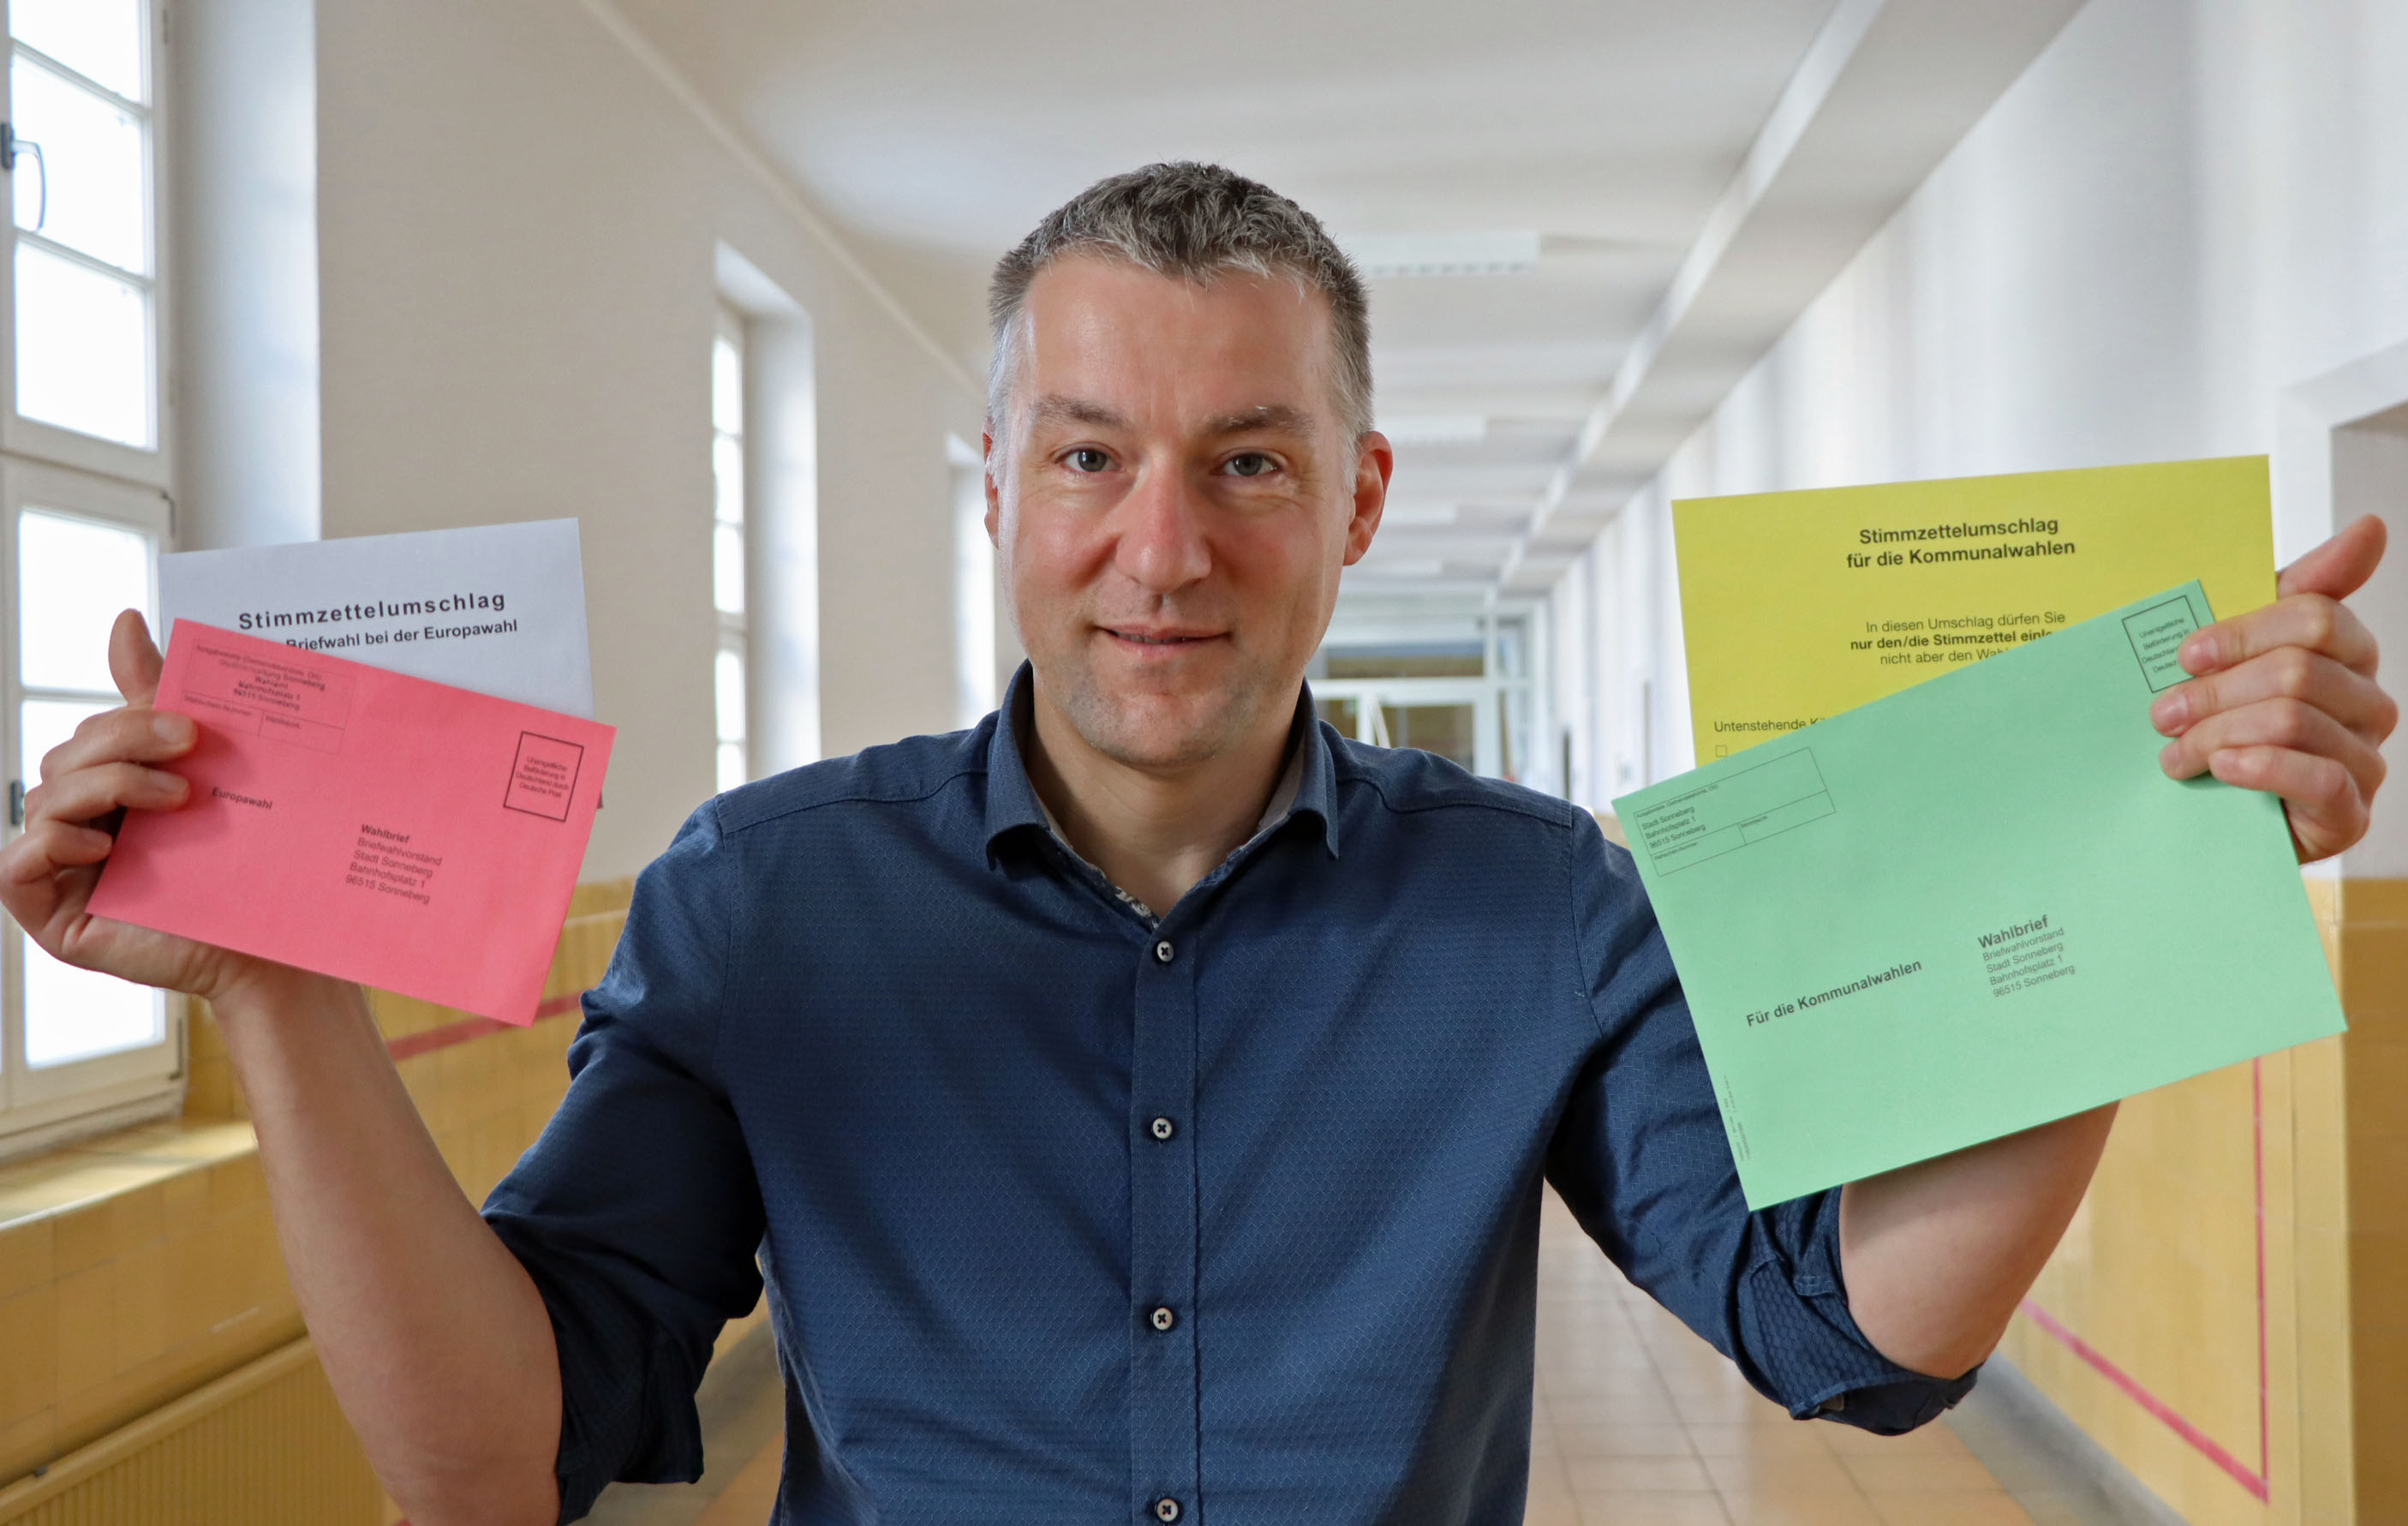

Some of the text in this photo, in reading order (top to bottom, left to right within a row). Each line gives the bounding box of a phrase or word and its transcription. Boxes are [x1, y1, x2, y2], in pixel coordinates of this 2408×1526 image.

[1860, 518, 2058, 544] Stimmzettelumschlag
[1847, 541, 2076, 568] für die Kommunalwahlen
[239, 593, 505, 630] Stimmzettelumschlag
[1866, 611, 2065, 632] In diesen Umschlag dürfen Sie
[365, 631, 389, 644] bei
[393, 629, 418, 643] der
[424, 619, 517, 640] Europawahl
[1850, 639, 1873, 650] nur
[1877, 635, 1929, 649] den/die
[1933, 631, 2016, 646] Stimmzettel
[1880, 654, 1911, 665] nicht
[1915, 651, 1944, 663] aber
[1948, 650, 1973, 662] den
[1714, 719, 1807, 733] Untenstehende
[212, 787, 272, 810] Europawahl
[1641, 806, 1694, 830] Stadt Sonneberg
[1646, 819, 1690, 840] Bahnhofsplatz
[361, 823, 410, 843] Wahlbrief
[1649, 823, 1706, 849] 96515 Sonneberg
[354, 849, 433, 879] Stadt Sonneberg
[357, 837, 443, 866] Briefwahlvorstand
[350, 861, 417, 886] Bahnhofsplatz
[345, 874, 430, 905] 96515 Sonneberg
[1978, 914, 2048, 949] Wahlbrief
[1982, 927, 2064, 961] Briefwahlvorstand
[1987, 943, 2064, 973] Stadt Sonneberg
[1989, 958, 2055, 985] Bahnhofsplatz
[1993, 965, 2075, 997] 96515 Sonneberg
[1747, 960, 1922, 1026] Für die Kommunalwahlen
